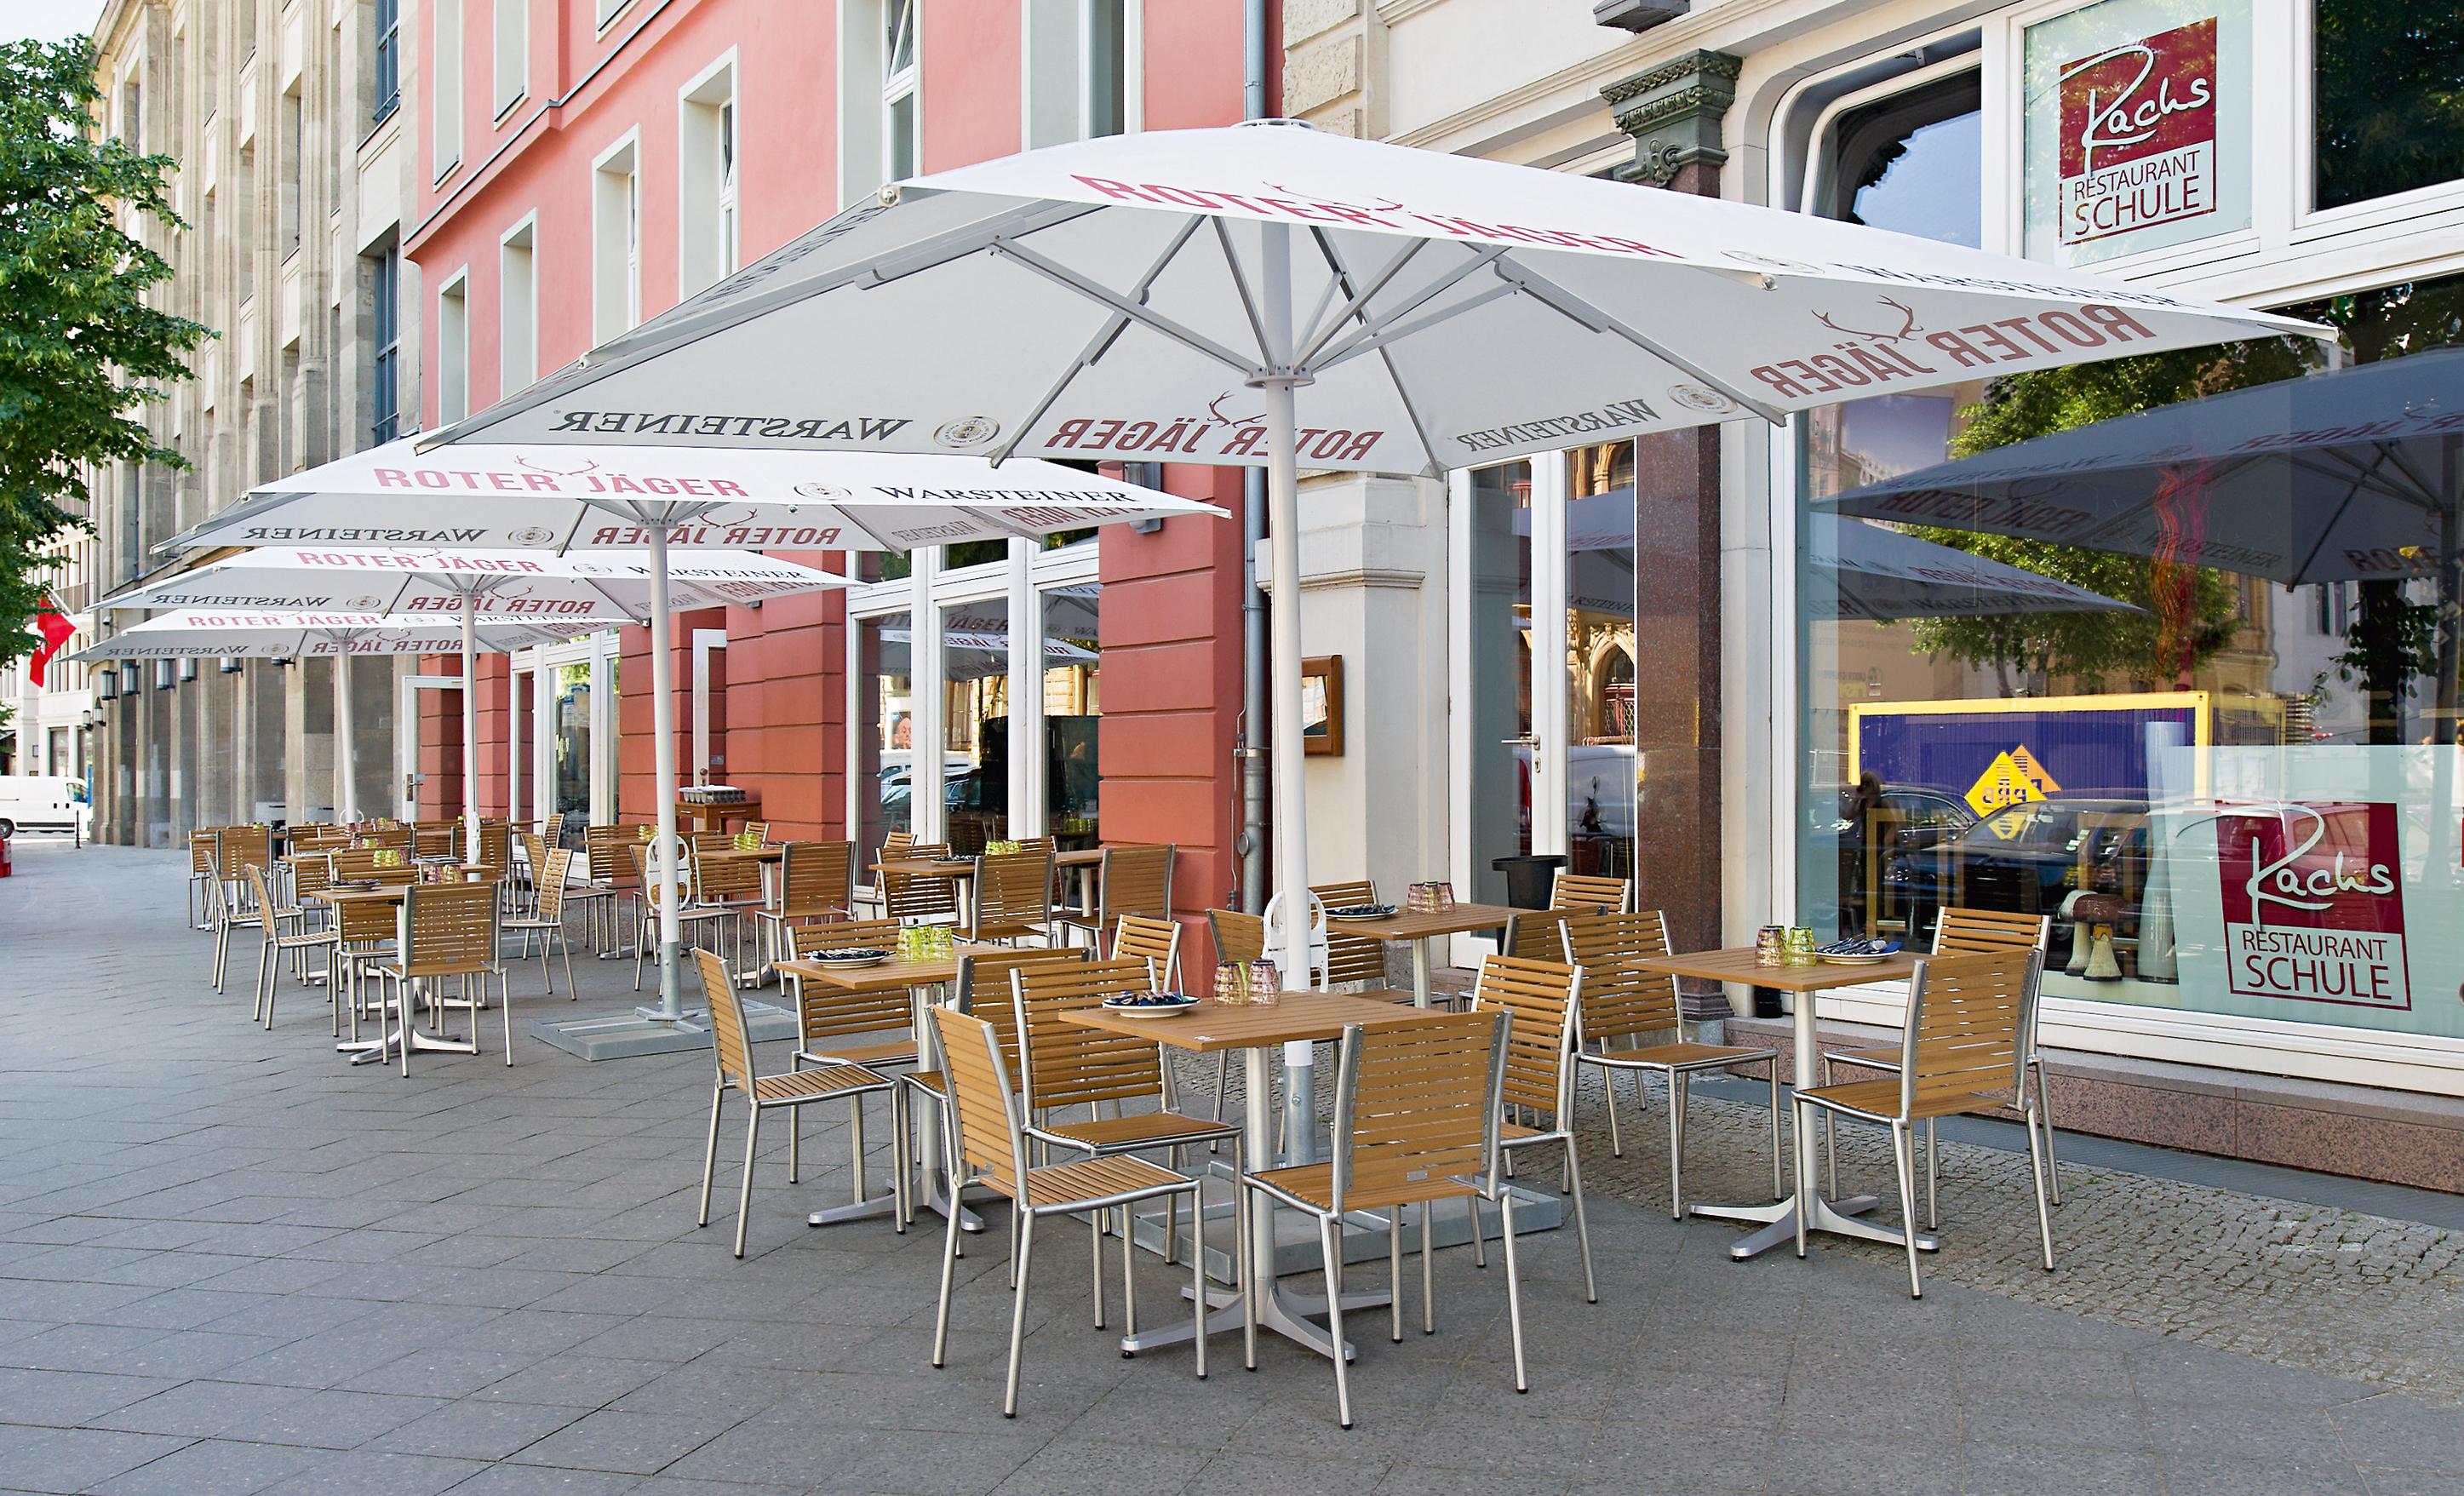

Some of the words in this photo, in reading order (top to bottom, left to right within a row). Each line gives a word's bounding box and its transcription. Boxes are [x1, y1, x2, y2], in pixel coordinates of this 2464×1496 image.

[2073, 149, 2201, 202] RESTAURANT
[1070, 174, 1405, 229] ROTER
[1413, 215, 1687, 259] JÄGER
[2074, 175, 2200, 236] SCHULE
[373, 467, 561, 491] ROTER
[585, 473, 750, 496] JÄGER
[871, 486, 1139, 502] WARSTEINER
[296, 552, 421, 568] ROTER
[435, 556, 545, 573] JÄGER
[626, 566, 811, 579] WRSTEINER
[187, 616, 282, 628] ROTER
[296, 615, 380, 625] JÄGER
[2242, 929, 2388, 961] RESTAURANT
[2245, 954, 2392, 1001] SCHULE
